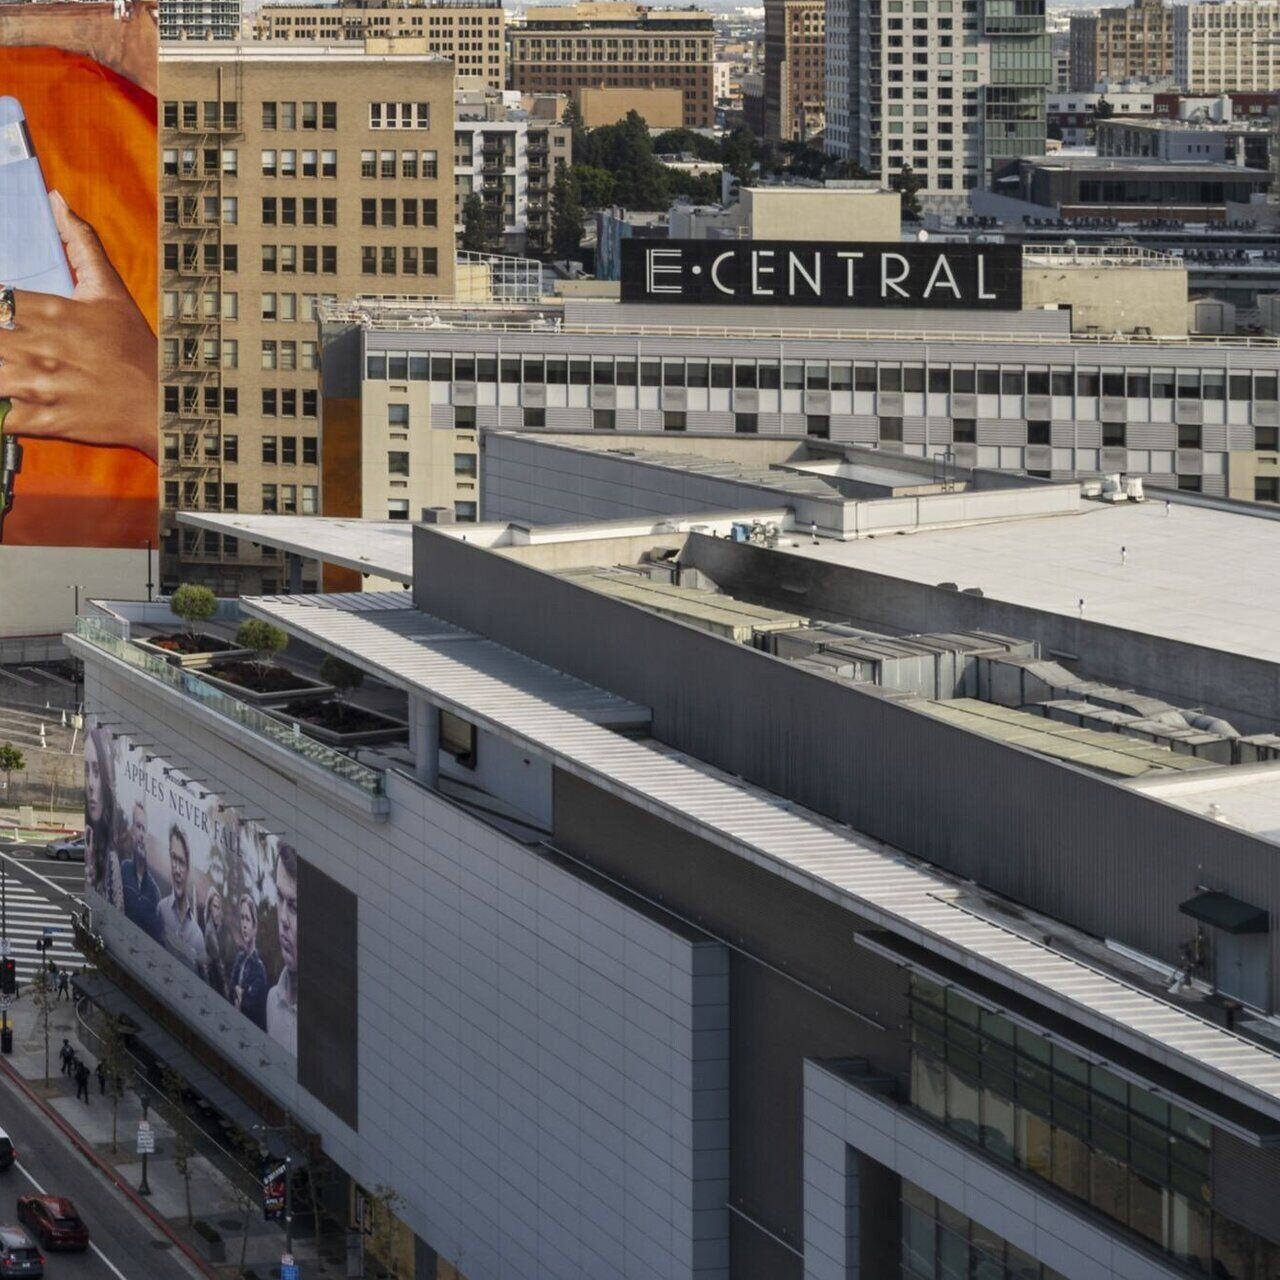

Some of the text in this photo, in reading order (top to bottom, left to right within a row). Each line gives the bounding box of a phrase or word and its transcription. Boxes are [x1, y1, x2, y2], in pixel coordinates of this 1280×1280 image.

[125, 760, 165, 803] APPLES
[169, 789, 209, 834] NEVER
[213, 820, 243, 858] FALL
